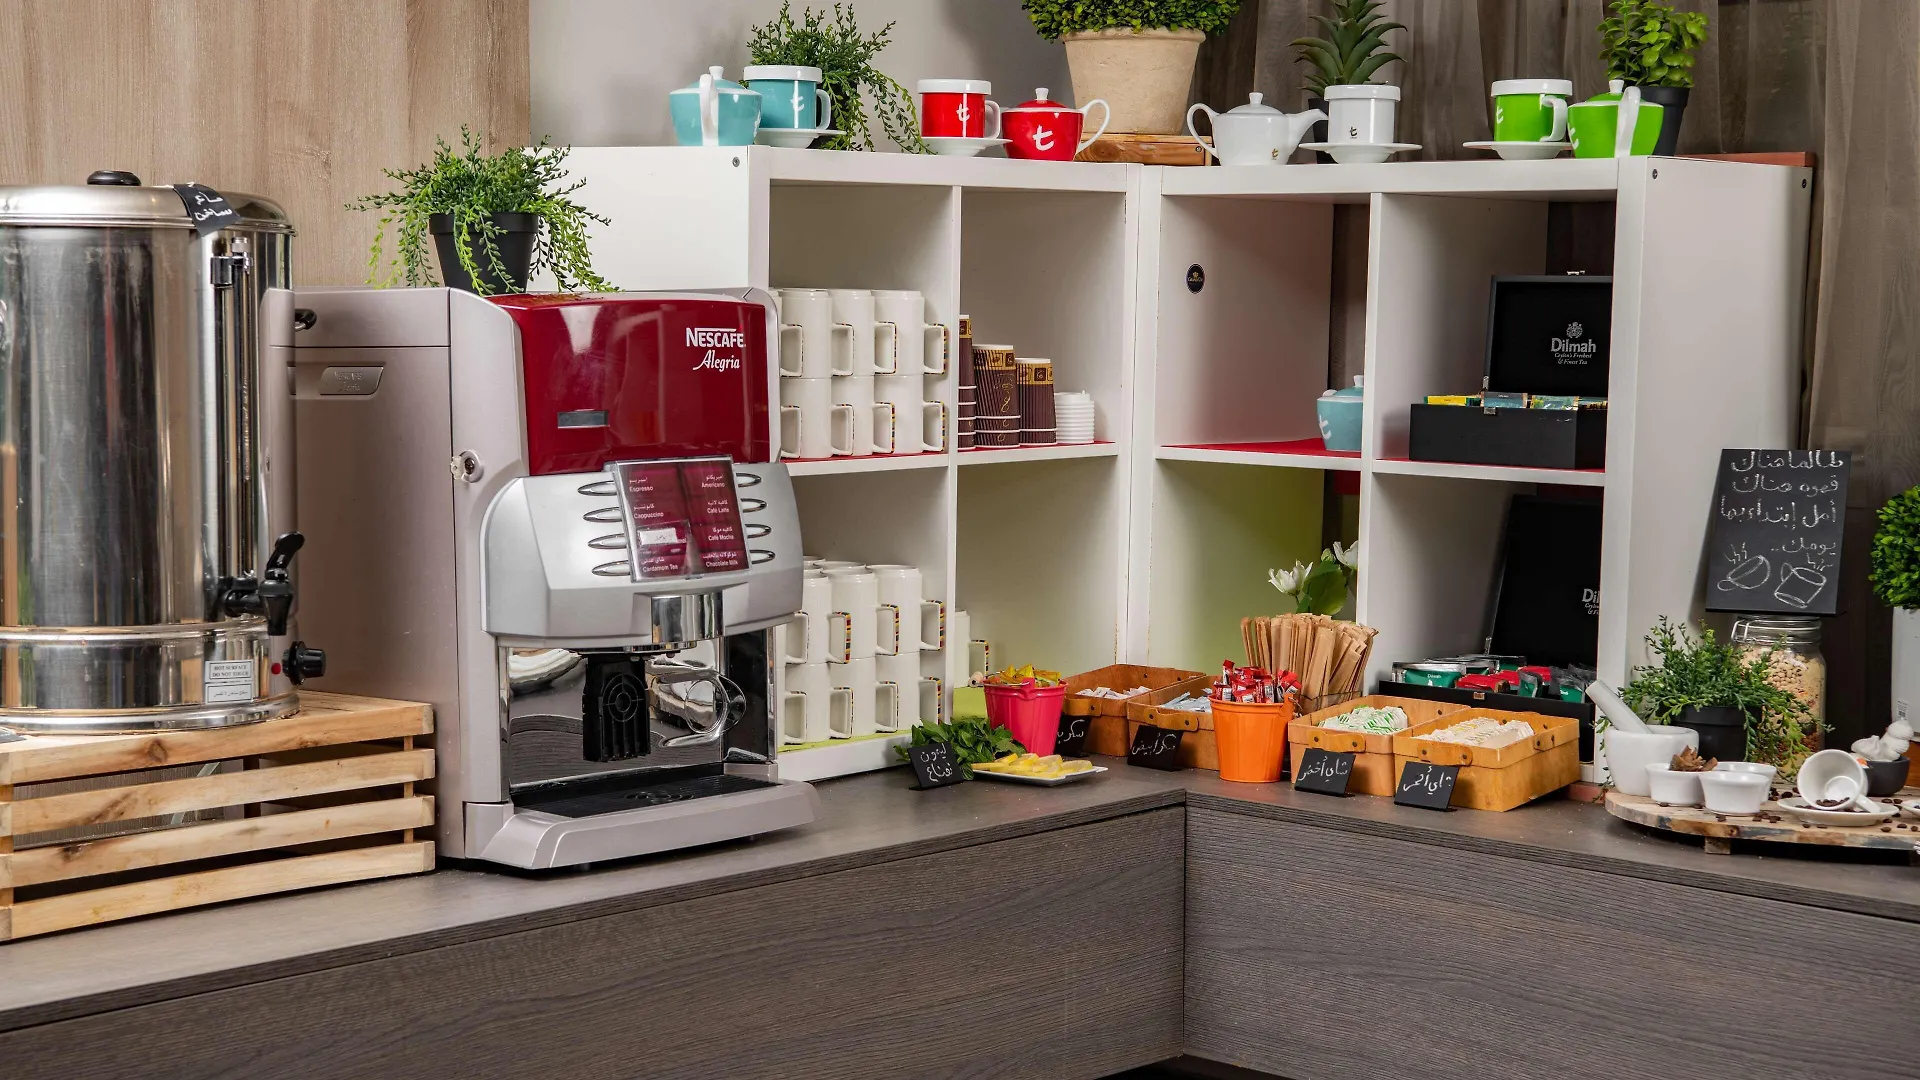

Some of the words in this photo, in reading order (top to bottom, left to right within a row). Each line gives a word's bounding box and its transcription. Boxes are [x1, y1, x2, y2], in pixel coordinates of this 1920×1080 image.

[1033, 125, 1055, 151] t
[1551, 338, 1596, 352] Dilmah
[692, 349, 741, 373] Alegria
[629, 485, 654, 493] Espresso
[633, 511, 665, 520] Cappuccino
[642, 564, 670, 572] Cardamom
[705, 560, 729, 568] Chocolate
[1582, 588, 1600, 603] Dil
[1324, 758, 1349, 783] شاي
